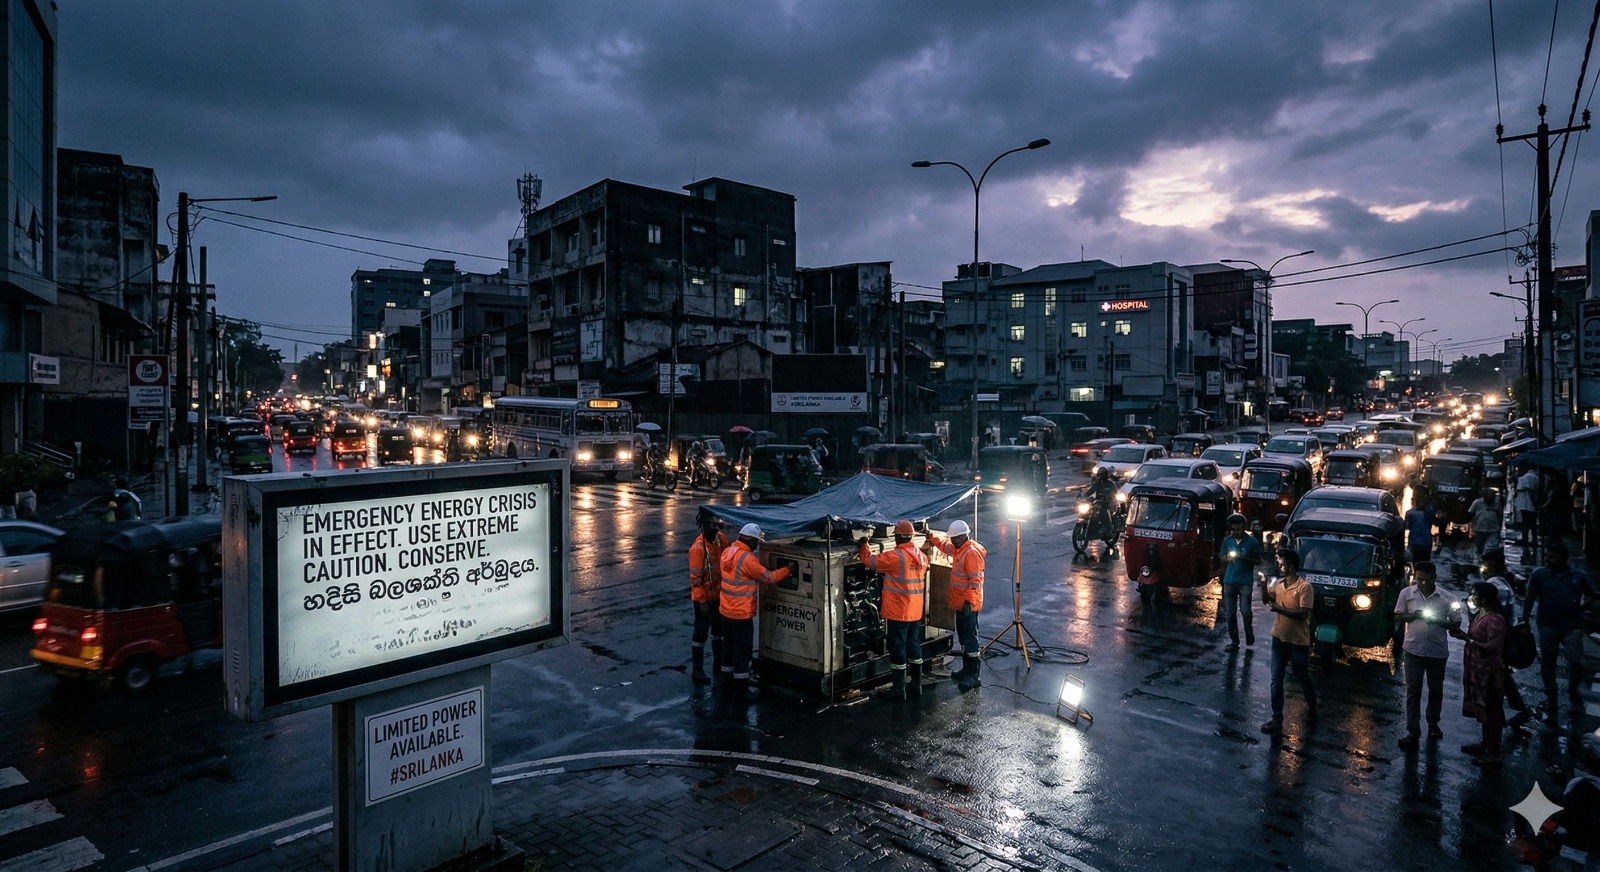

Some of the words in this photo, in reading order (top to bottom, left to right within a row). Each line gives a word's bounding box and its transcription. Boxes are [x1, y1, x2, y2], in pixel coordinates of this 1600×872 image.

[1111, 301, 1149, 310] HOSPITAL
[303, 503, 415, 535] EMERGENCY
[421, 497, 484, 521] ENERGY
[488, 492, 537, 514] CRISIS
[303, 537, 323, 559] IN
[330, 528, 402, 556] EFFECT.
[408, 523, 441, 545] USE
[447, 514, 519, 540] EXTREME
[303, 553, 392, 583] CAUTION.
[399, 539, 491, 569] CONSERVE.
[303, 582, 361, 612] හදිසි
[765, 601, 817, 622] EMERGENCY
[776, 617, 806, 632] POWER
[374, 713, 428, 744] LIMITED
[432, 700, 477, 727] POWER
[390, 723, 464, 760] AVAILABLE.
[390, 747, 464, 785] #SRILANKA
